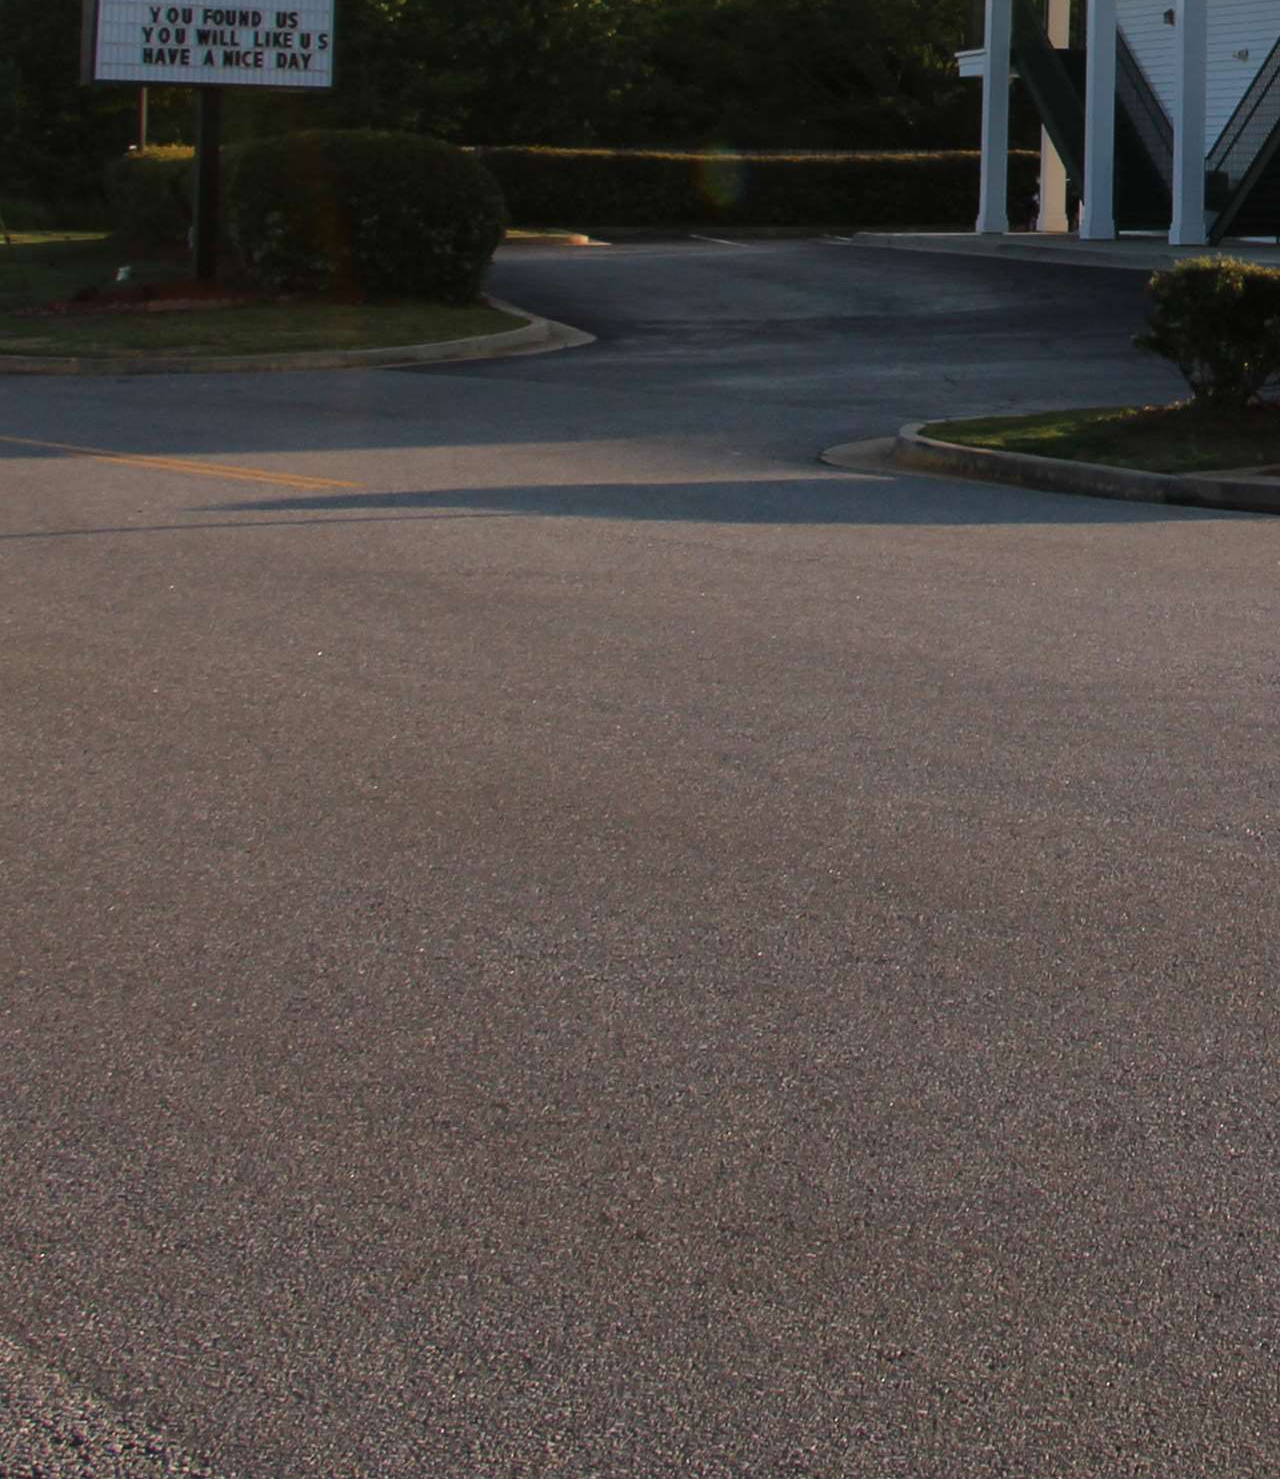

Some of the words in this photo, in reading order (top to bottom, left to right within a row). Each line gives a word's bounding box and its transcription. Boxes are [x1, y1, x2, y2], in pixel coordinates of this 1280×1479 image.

[149, 6, 193, 25] YOU
[203, 8, 262, 27] FOUND
[276, 12, 299, 28] US
[142, 27, 186, 45] YOU
[196, 29, 240, 46] WILL
[254, 31, 293, 48] LIKE
[143, 48, 190, 65] HAVE
[203, 50, 214, 66] A
[223, 51, 263, 68] NICE
[276, 52, 312, 69] DAY
